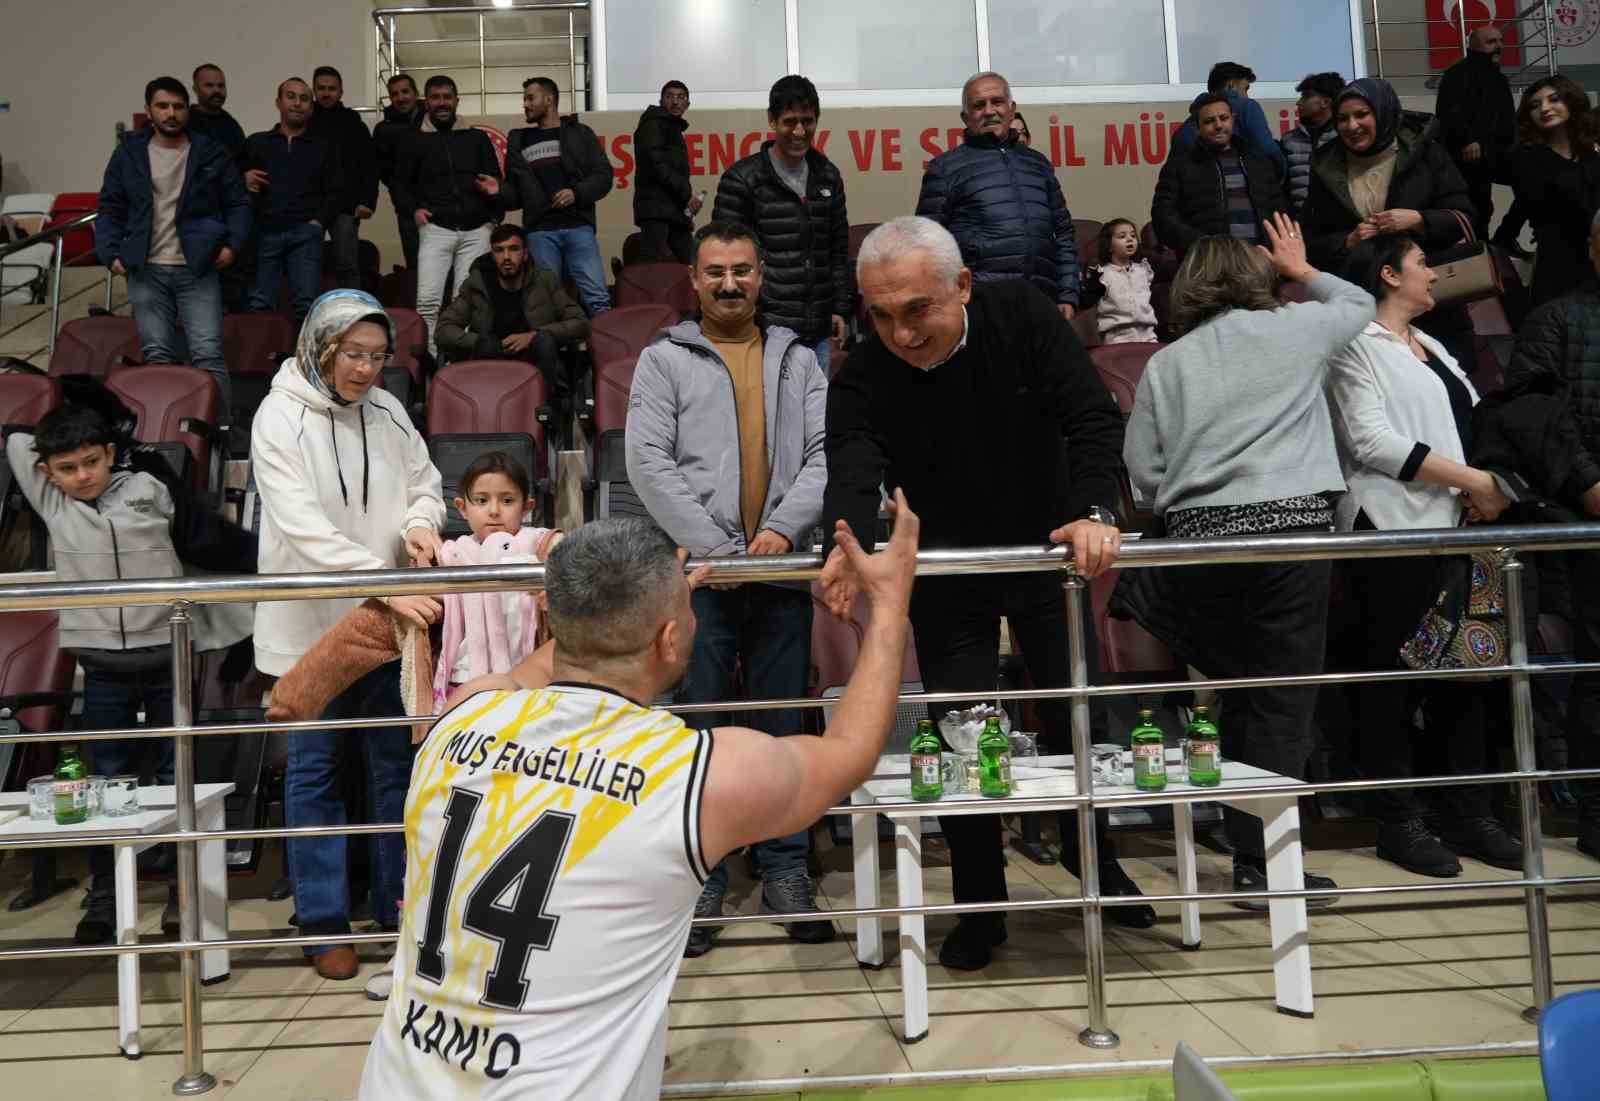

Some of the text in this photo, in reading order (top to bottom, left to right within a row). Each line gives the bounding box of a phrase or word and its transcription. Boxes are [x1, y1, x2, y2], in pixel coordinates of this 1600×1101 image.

[847, 128, 903, 172] VE
[1049, 113, 1086, 168] İL
[440, 729, 496, 776] MUŞ
[415, 786, 577, 1013] 14
